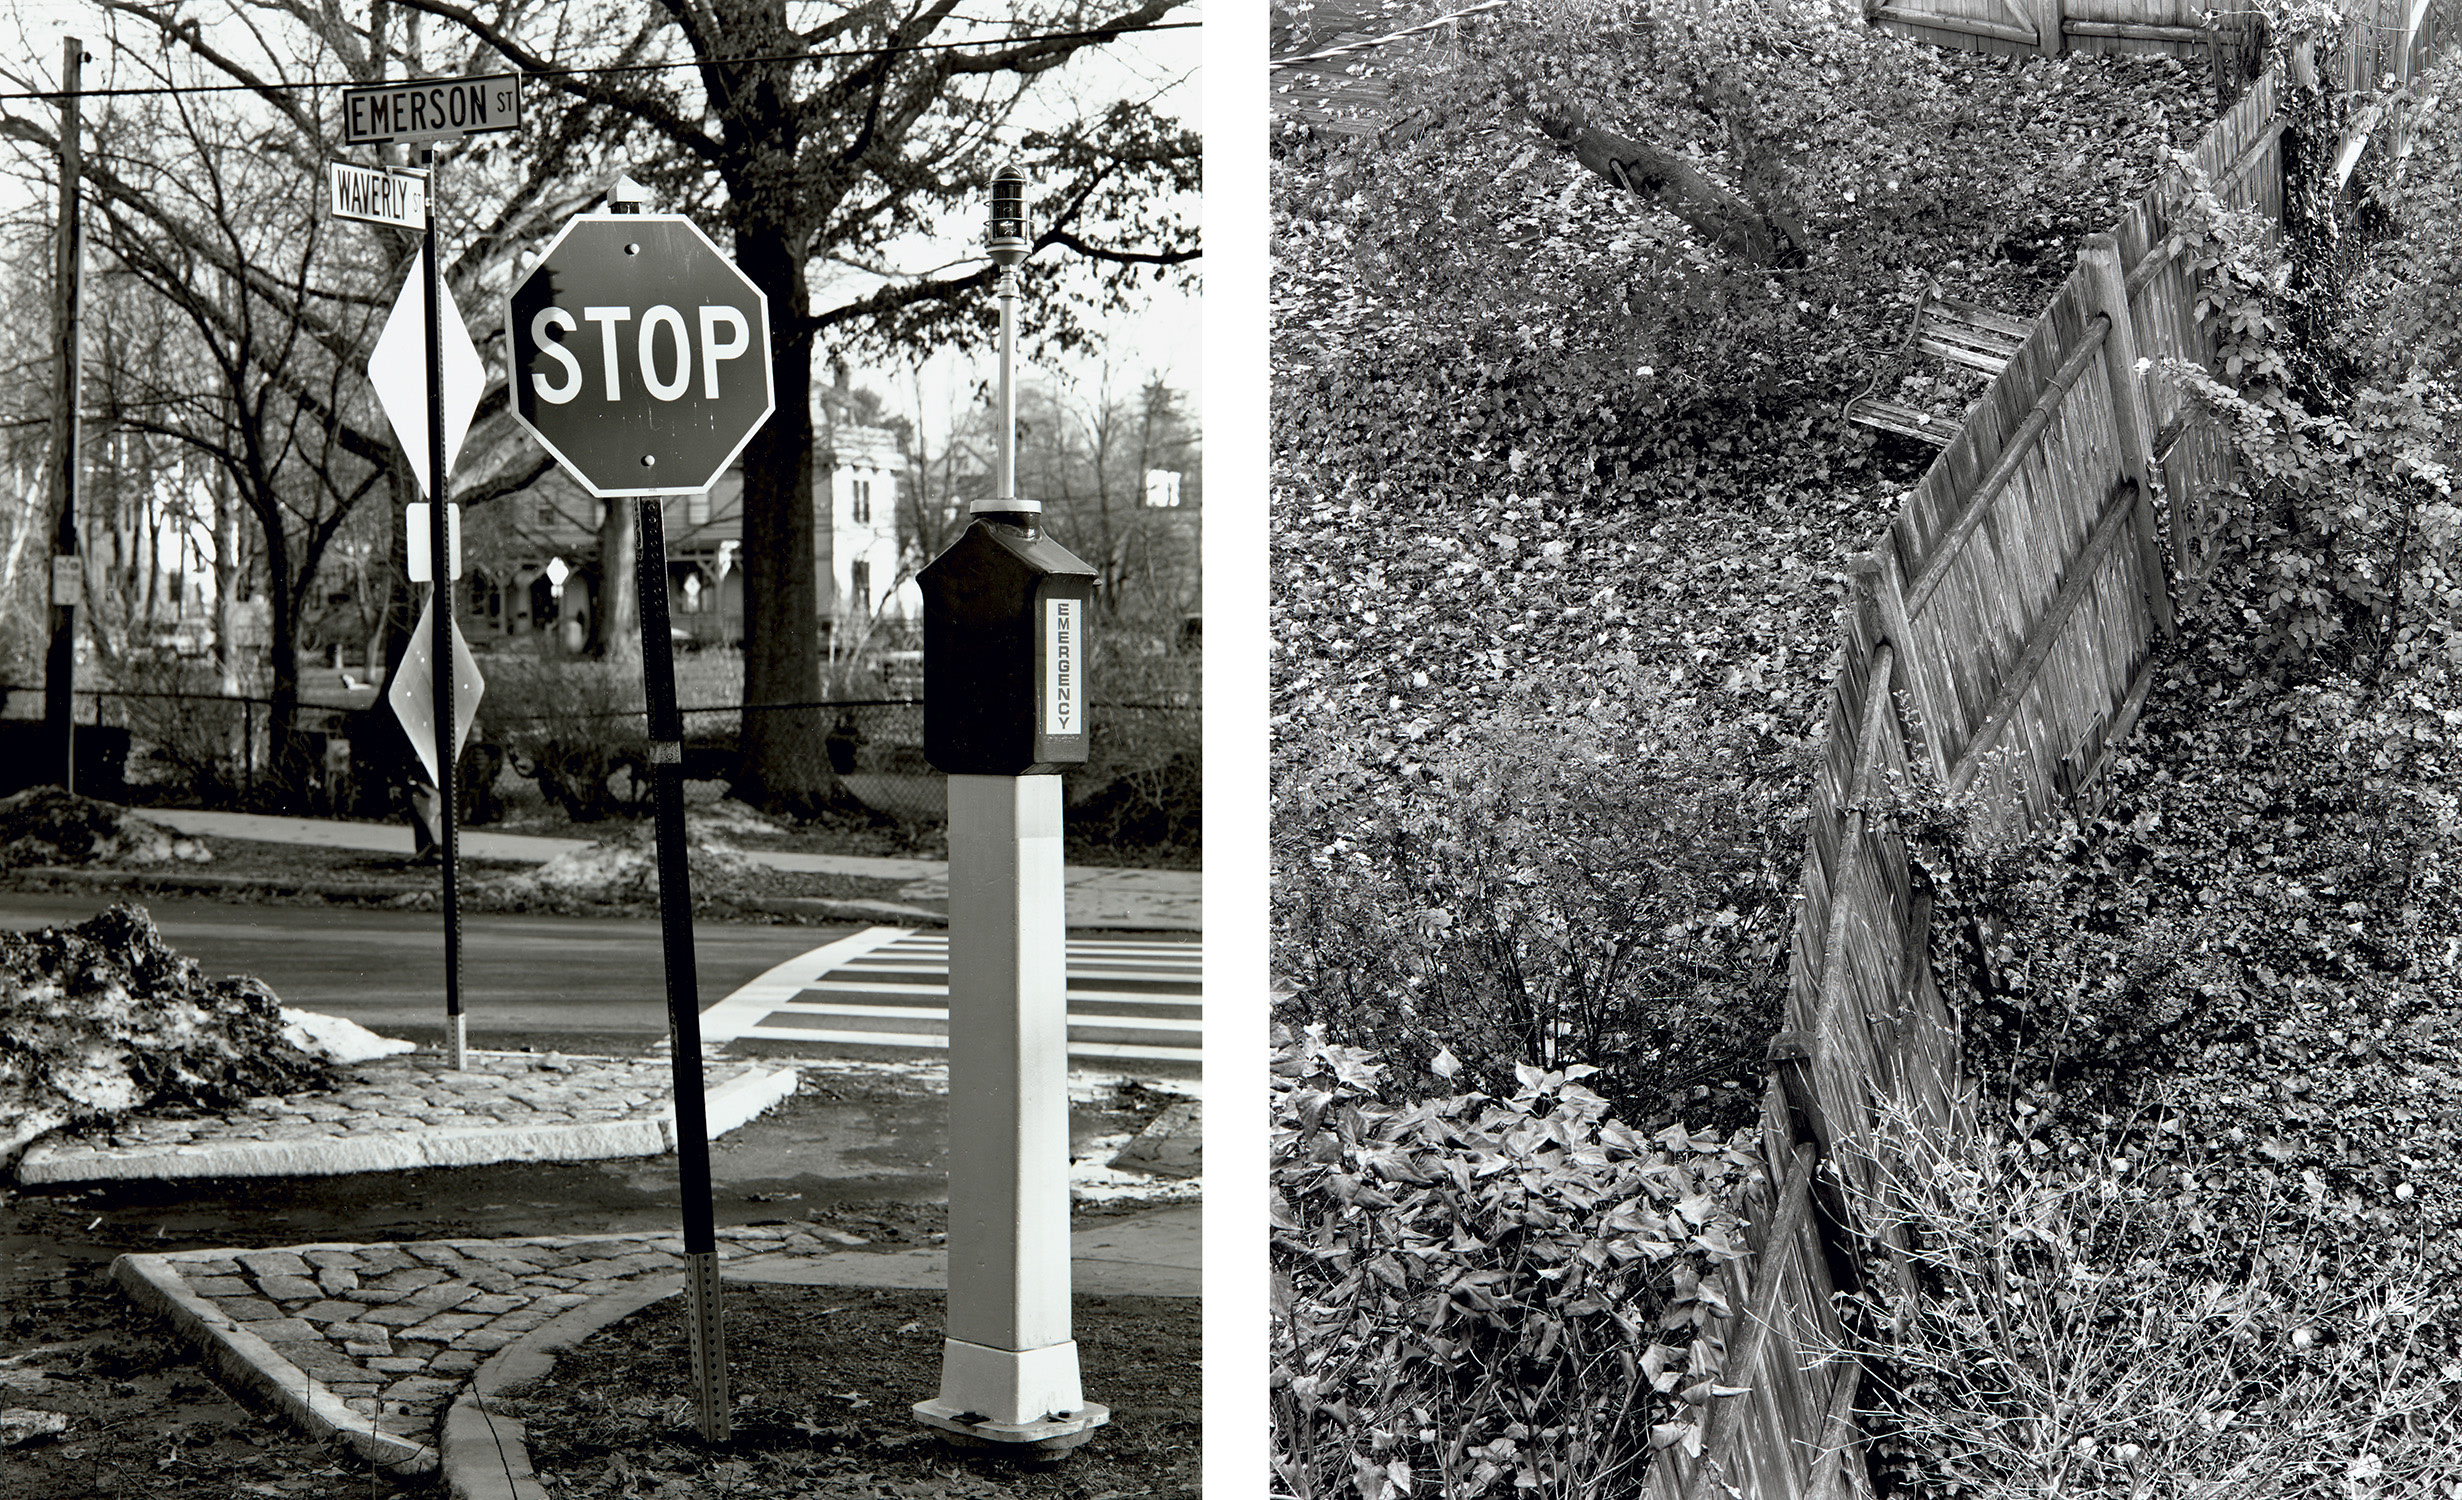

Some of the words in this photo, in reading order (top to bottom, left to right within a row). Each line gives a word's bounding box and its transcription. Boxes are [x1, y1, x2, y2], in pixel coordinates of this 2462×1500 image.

[351, 84, 487, 136] EMERSON
[497, 91, 513, 113] ST
[337, 169, 408, 221] WAVERLY
[413, 192, 421, 213] ST
[531, 304, 750, 405] STOP
[1057, 603, 1070, 730] EMERGENCY
